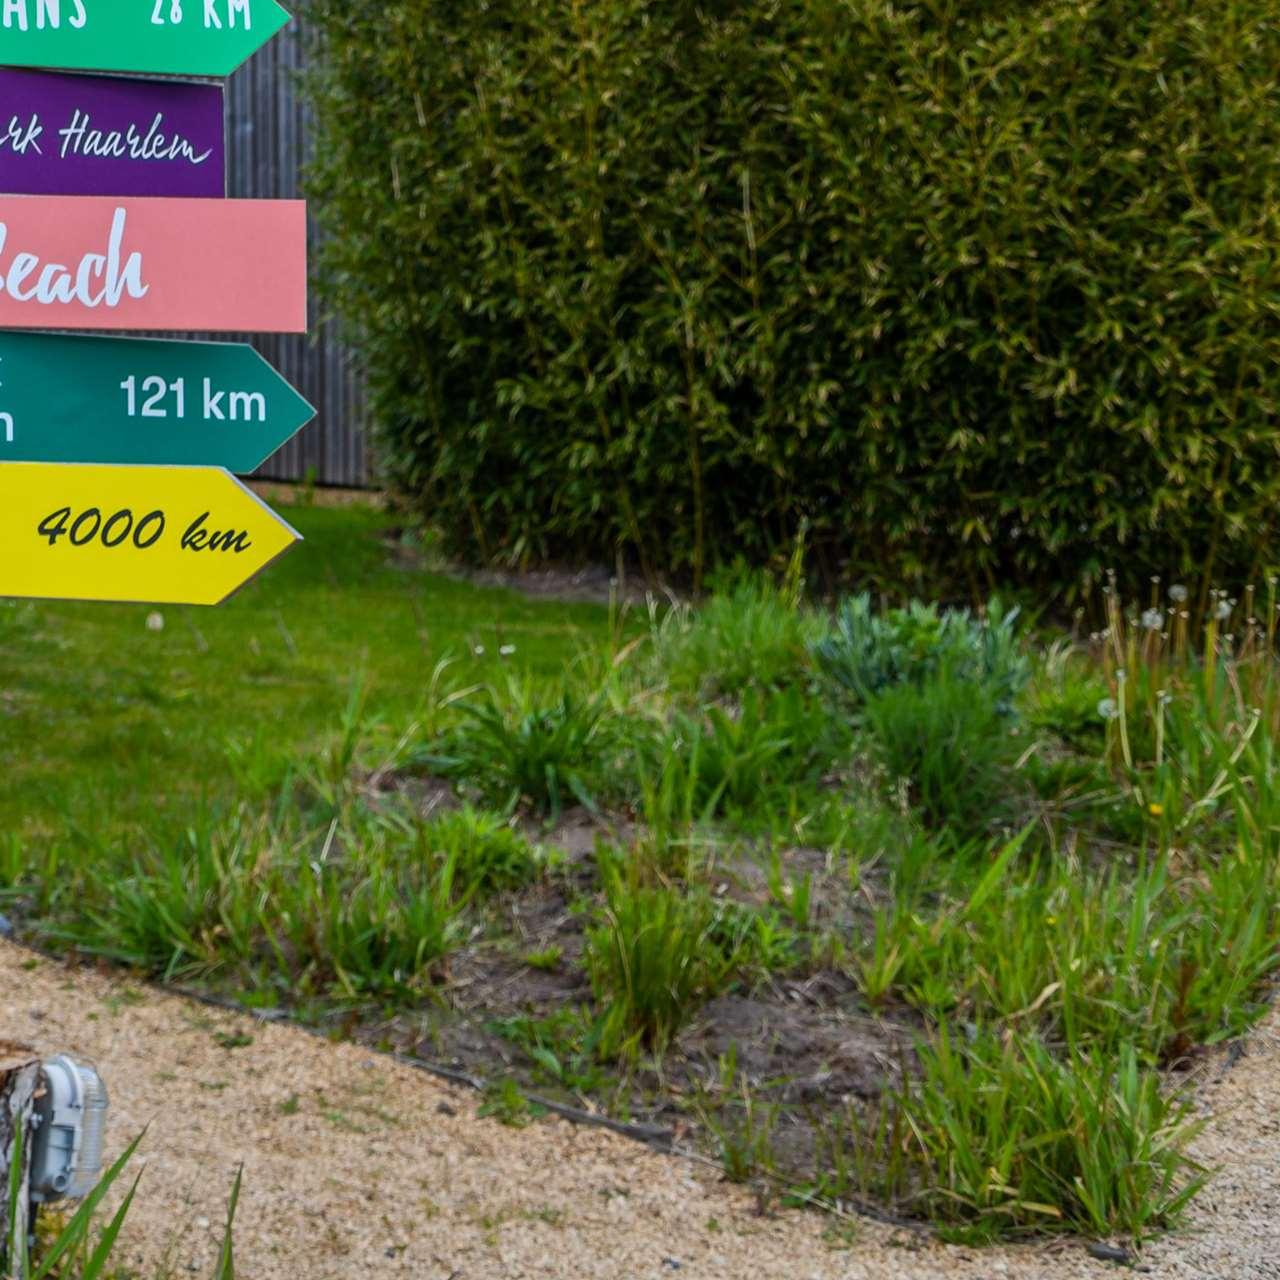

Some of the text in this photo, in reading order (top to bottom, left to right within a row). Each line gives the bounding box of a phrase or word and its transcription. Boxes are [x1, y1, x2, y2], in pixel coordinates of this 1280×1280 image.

[58, 110, 214, 166] Haarlem
[119, 375, 266, 422] 121 km
[37, 505, 252, 554] 4000 km
